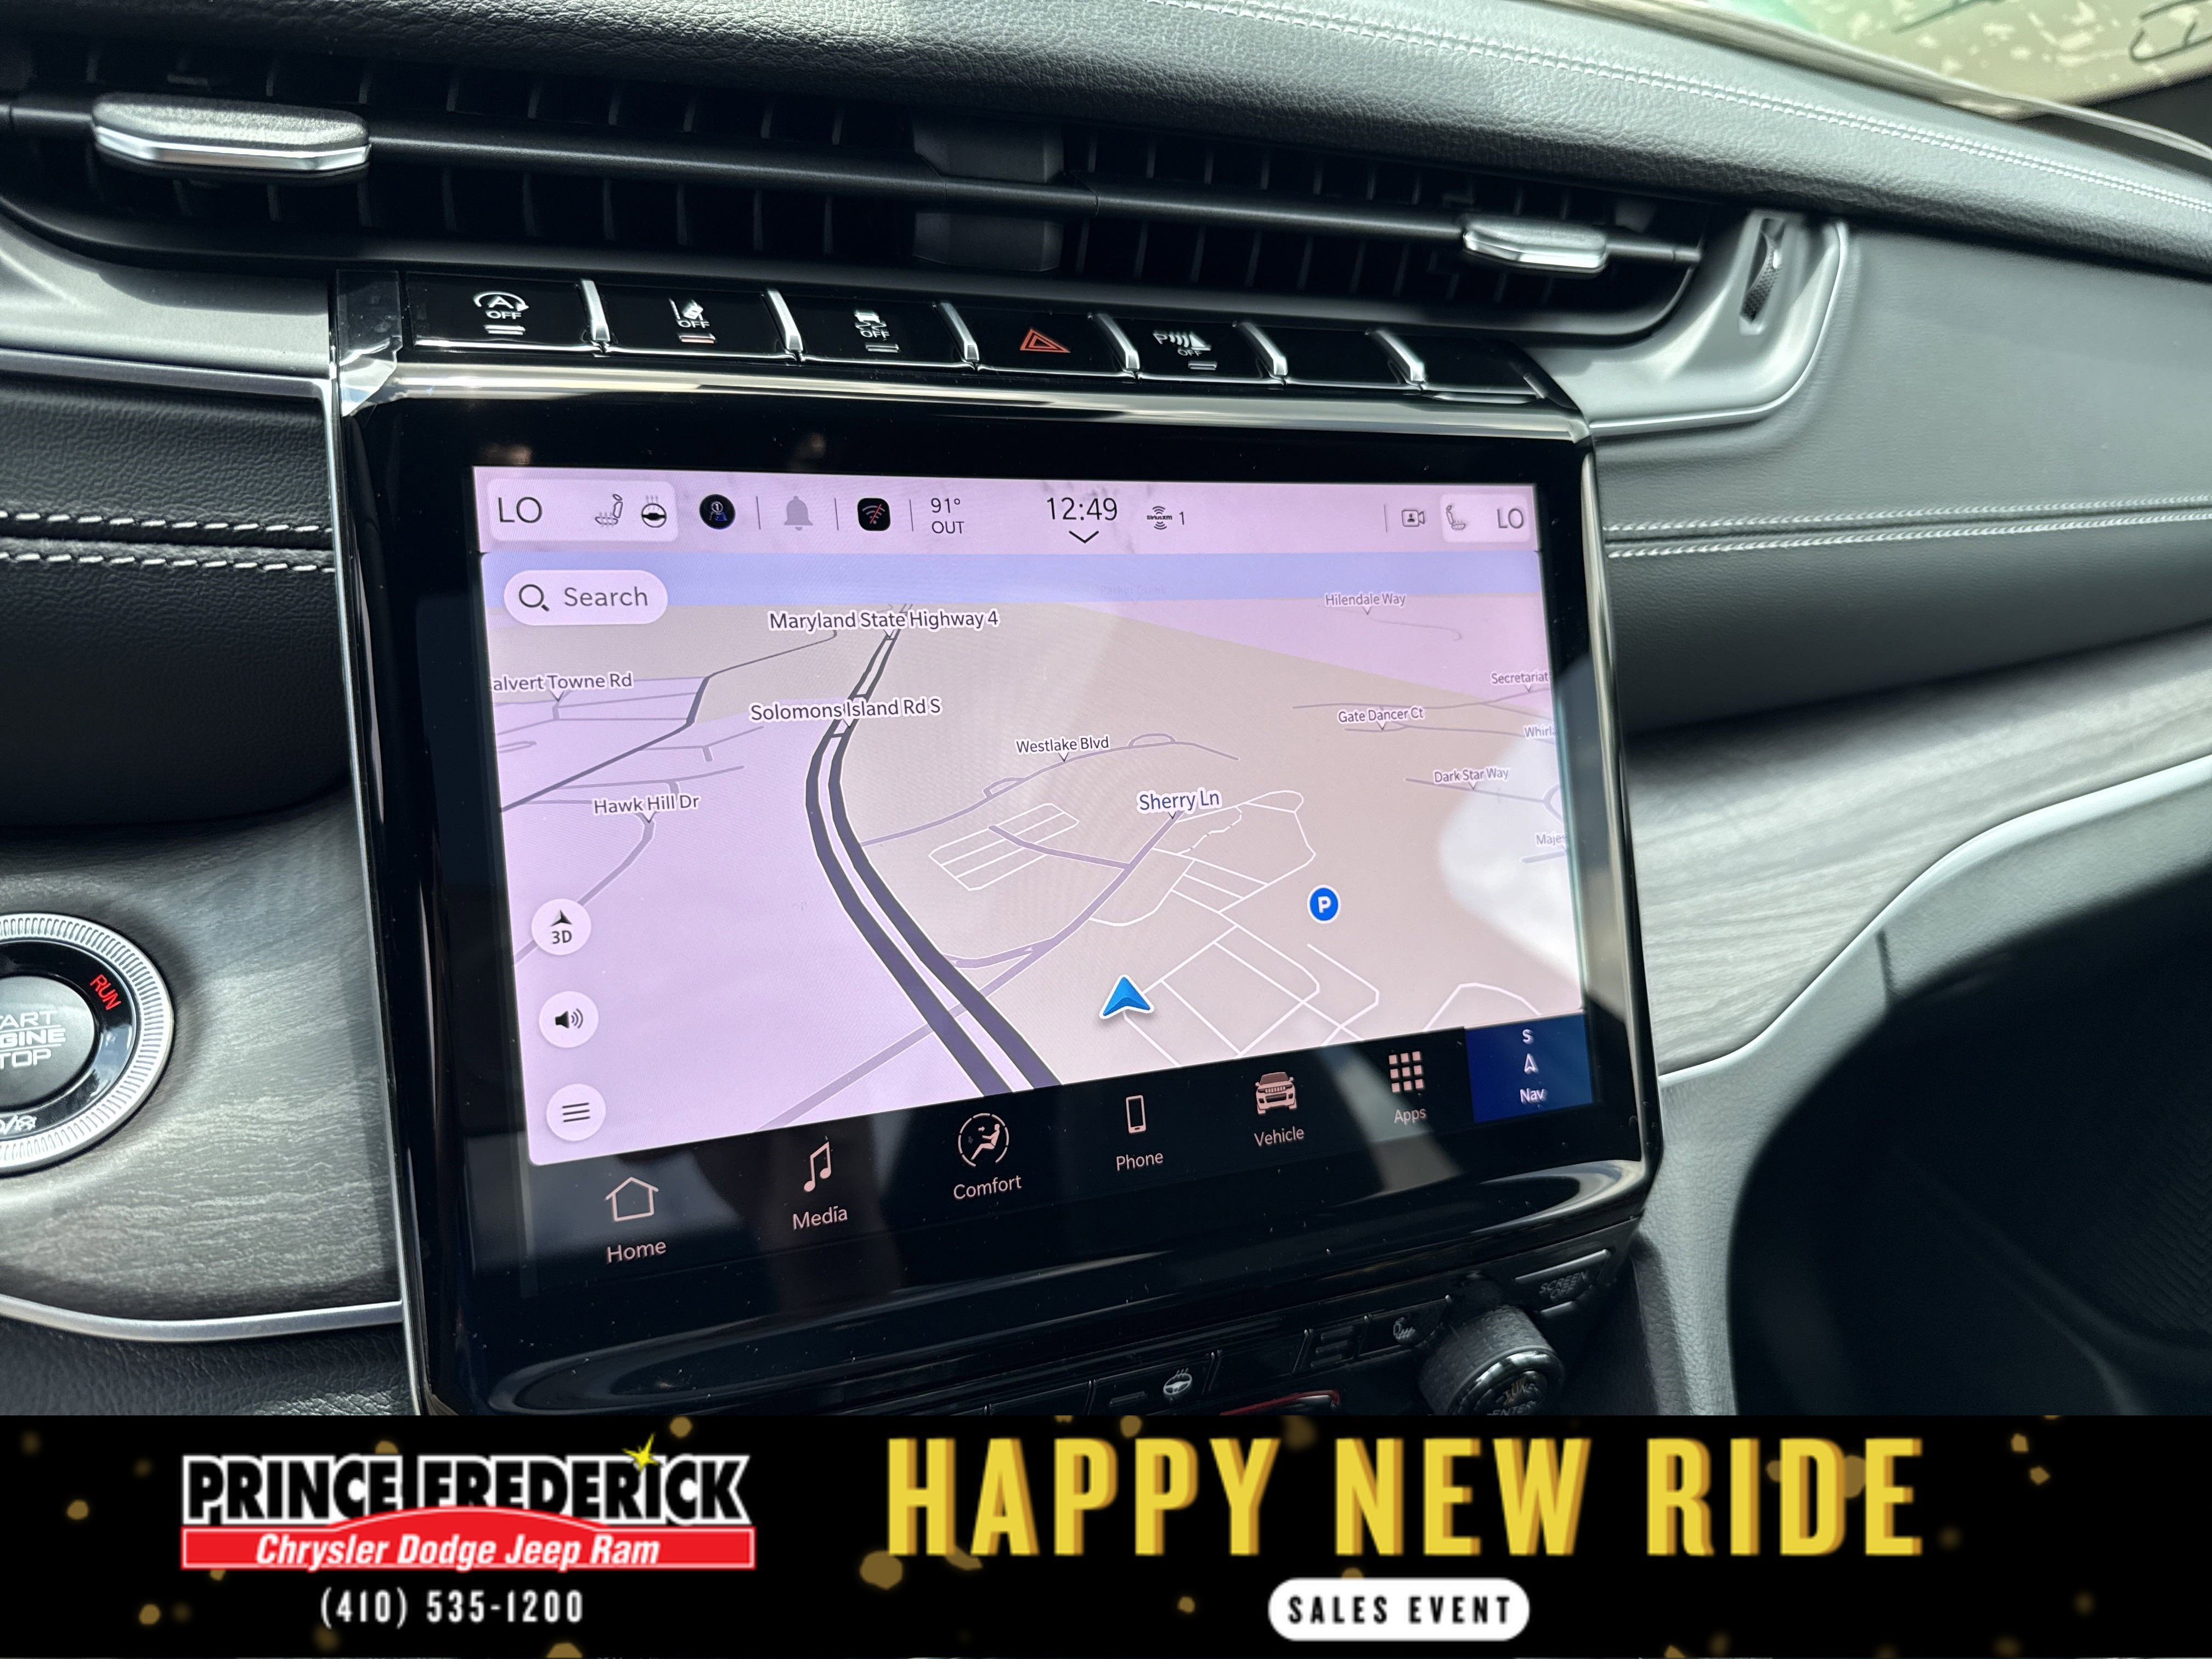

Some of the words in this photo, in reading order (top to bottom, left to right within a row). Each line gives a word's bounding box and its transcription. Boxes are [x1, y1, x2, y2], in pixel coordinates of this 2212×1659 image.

[486, 311, 522, 320] OFF
[678, 319, 710, 329] OFF
[860, 329, 890, 338] OFF
[1178, 348, 1203, 357] OFF
[498, 496, 543, 523] LO
[931, 498, 961, 514] 91°
[1047, 497, 1118, 521] 12:49
[1179, 511, 1185, 526] 1
[1497, 508, 1524, 529] LO
[932, 521, 964, 534] OUT
[564, 586, 648, 607] Search
[1325, 594, 1380, 606] Hilendale
[1382, 594, 1406, 607] Way
[770, 612, 856, 632] Maryland
[861, 612, 906, 628] State
[910, 611, 984, 630] Highway
[988, 611, 998, 625] 4
[494, 676, 544, 691] alvert
[546, 675, 606, 689] Towne
[610, 673, 633, 687] Rd
[1491, 672, 1548, 685] Secretariat
[751, 704, 842, 720] Solomons
[847, 700, 899, 717] Island
[904, 699, 927, 714] Rd
[930, 698, 941, 713] S
[1339, 711, 1365, 723] Gate
[1368, 709, 1408, 721] Dancer
[1411, 707, 1423, 719] Ct
[1017, 737, 1077, 753] Westlake
[1081, 736, 1109, 749] Blvd
[1435, 771, 1460, 783] Dark
[1462, 769, 1483, 781] Star
[1486, 768, 1509, 781] Way
[594, 798, 643, 814] Hawk
[648, 795, 675, 810] Hill
[680, 794, 699, 809] Dr
[1139, 793, 1196, 810] Sherry
[1200, 790, 1220, 806] Ln
[1317, 896, 1331, 913] P
[551, 930, 572, 944] 3D
[89, 974, 122, 1011] RUN
[1522, 1029, 1533, 1044] S
[1520, 1088, 1547, 1104] Nav
[1393, 1107, 1426, 1125] Apps
[1254, 1126, 1305, 1148] Vehicle
[1116, 1151, 1163, 1171] Phone
[953, 1175, 1022, 1201] Comfort
[793, 1206, 848, 1230] Media
[606, 1240, 667, 1263] Home
